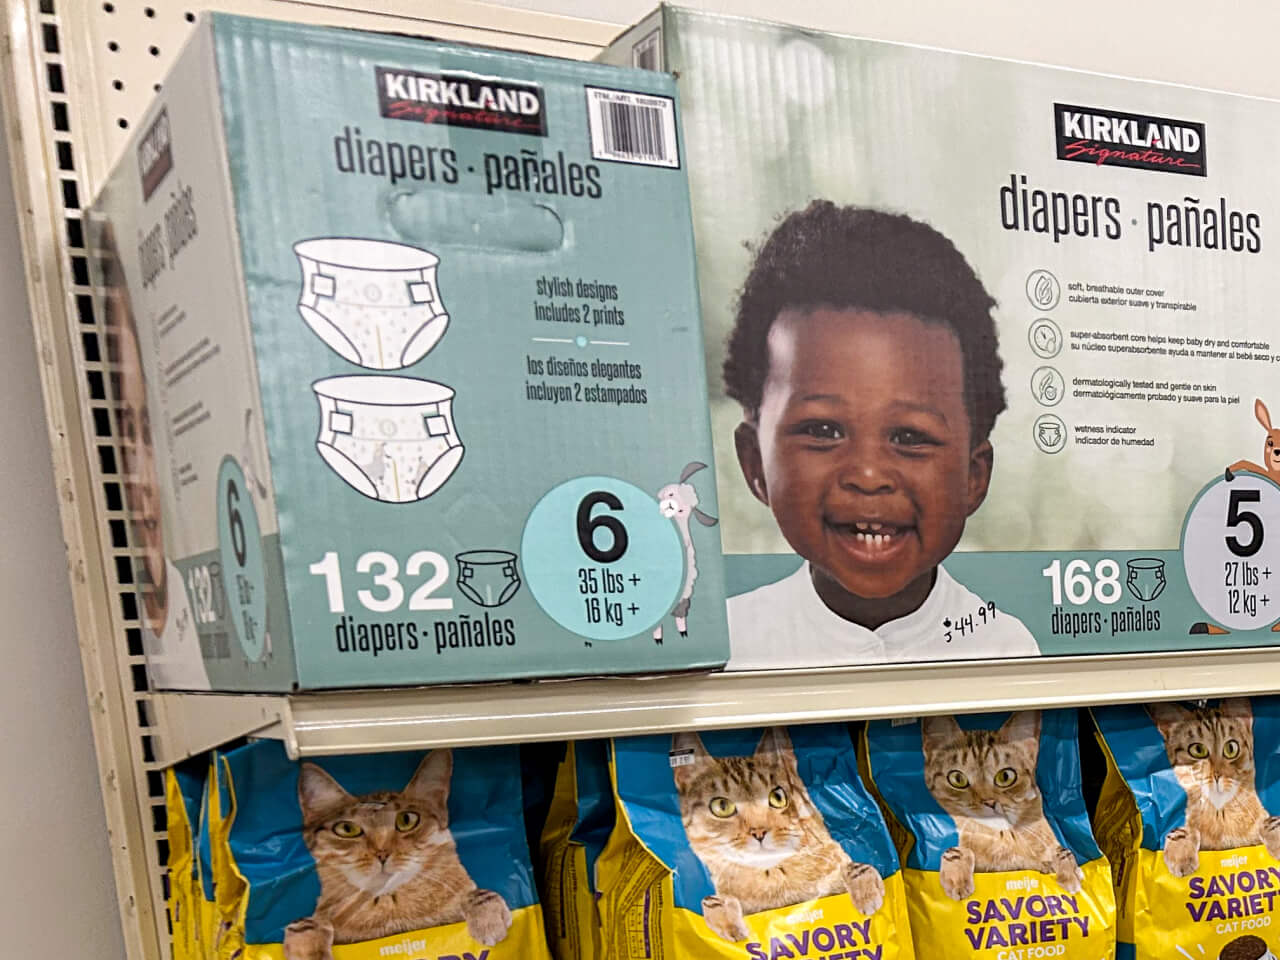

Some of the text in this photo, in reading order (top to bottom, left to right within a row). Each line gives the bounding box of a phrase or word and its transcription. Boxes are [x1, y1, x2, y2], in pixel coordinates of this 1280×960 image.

[383, 71, 540, 114] KIRKLAND
[386, 100, 540, 131] Signature
[1062, 111, 1200, 153] KIRKLAND
[334, 126, 602, 199] diapers pañales
[1064, 140, 1201, 168] Signature
[1000, 173, 1261, 253] diapers pañales
[536, 276, 618, 304] stylish designs
[1086, 284, 1124, 295] breathable
[1126, 286, 1144, 296] outer
[1146, 288, 1165, 297] cover
[534, 303, 625, 329] includes 2 prints
[527, 354, 642, 384] los diseños elegantes
[526, 382, 648, 406] incluyen 2 estampados
[1075, 425, 1136, 435] wetness indicator
[576, 490, 630, 564] 6
[1225, 489, 1264, 558] 5
[308, 551, 454, 614] 132
[578, 568, 625, 594] 35 lbs
[1043, 559, 1122, 605] 168
[1225, 562, 1259, 586] 27 lbs
[586, 599, 624, 626] 16 kg
[1228, 591, 1257, 617] 12 kg
[336, 615, 516, 657] diapers pañales
[1051, 606, 1161, 637] diapers pañales
[965, 894, 1081, 926] SAVORY
[964, 916, 1090, 952] VARIETY
[1216, 916, 1272, 936] CAT FOOD
[379, 937, 427, 957] meijer
